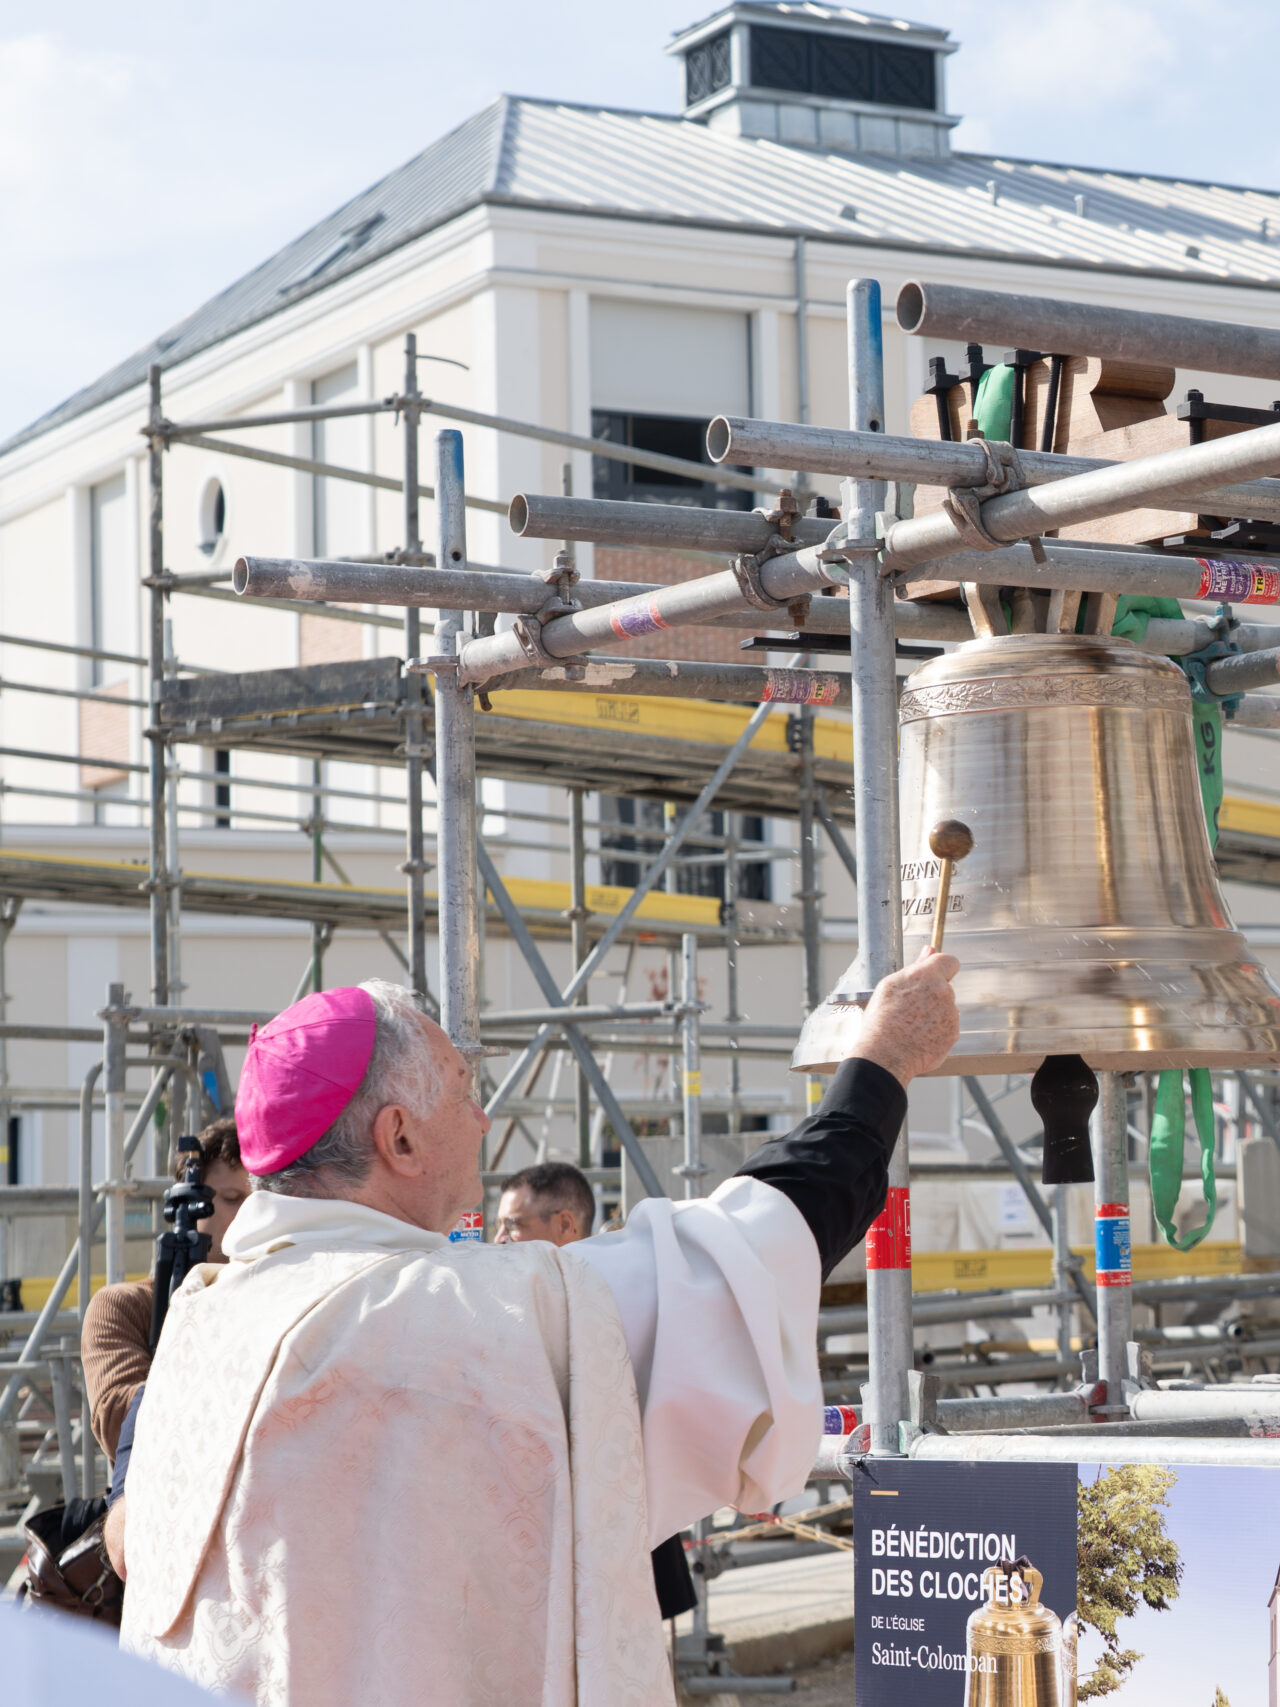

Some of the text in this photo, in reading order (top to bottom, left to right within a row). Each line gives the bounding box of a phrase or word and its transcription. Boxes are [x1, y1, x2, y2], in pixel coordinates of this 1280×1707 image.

[1201, 721, 1216, 776] KG
[871, 1523, 1016, 1562] BÉNÉDICTION
[871, 1568, 1023, 1603] DES CLOCHES
[871, 1614, 925, 1632] DE L'ÉGLISE
[871, 1642, 998, 1674] Saint-Colomban
